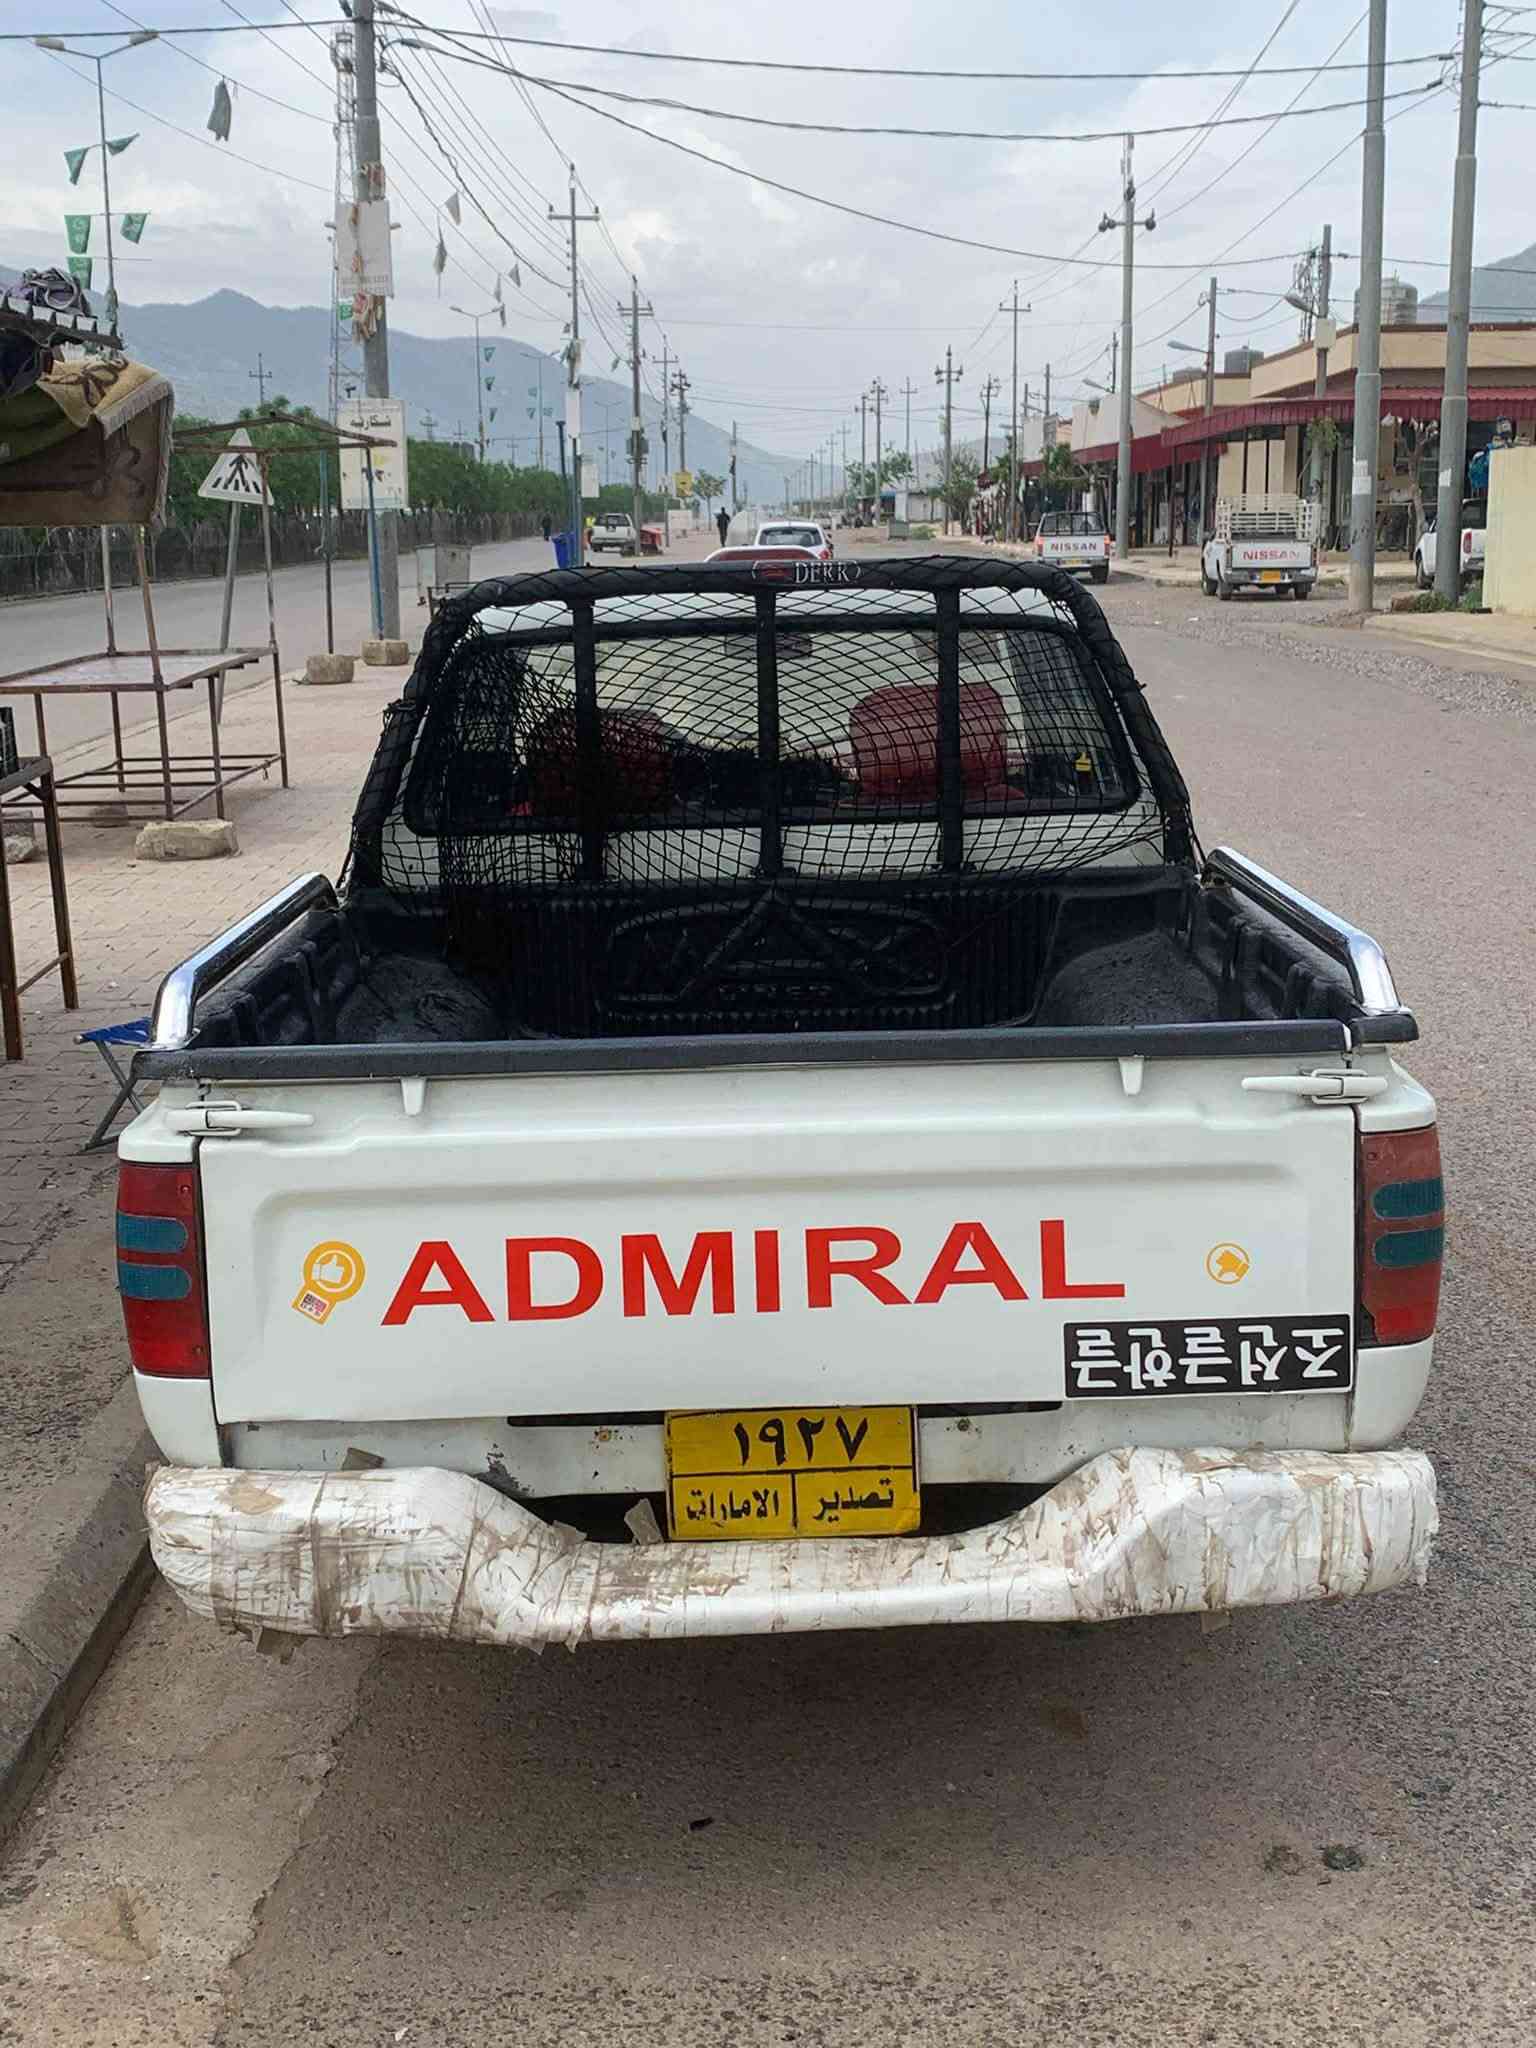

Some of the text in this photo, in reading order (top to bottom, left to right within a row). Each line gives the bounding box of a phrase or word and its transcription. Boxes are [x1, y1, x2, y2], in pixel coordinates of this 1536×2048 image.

[1050, 542, 1097, 551] NISSAN
[1242, 550, 1299, 561] NISSAN
[381, 1219, 1126, 1326] ADMIRAL
[1070, 1325, 1345, 1389] 조선글한글
[734, 1415, 869, 1466] ١٩٢٧
[813, 1477, 894, 1523] تصدير
